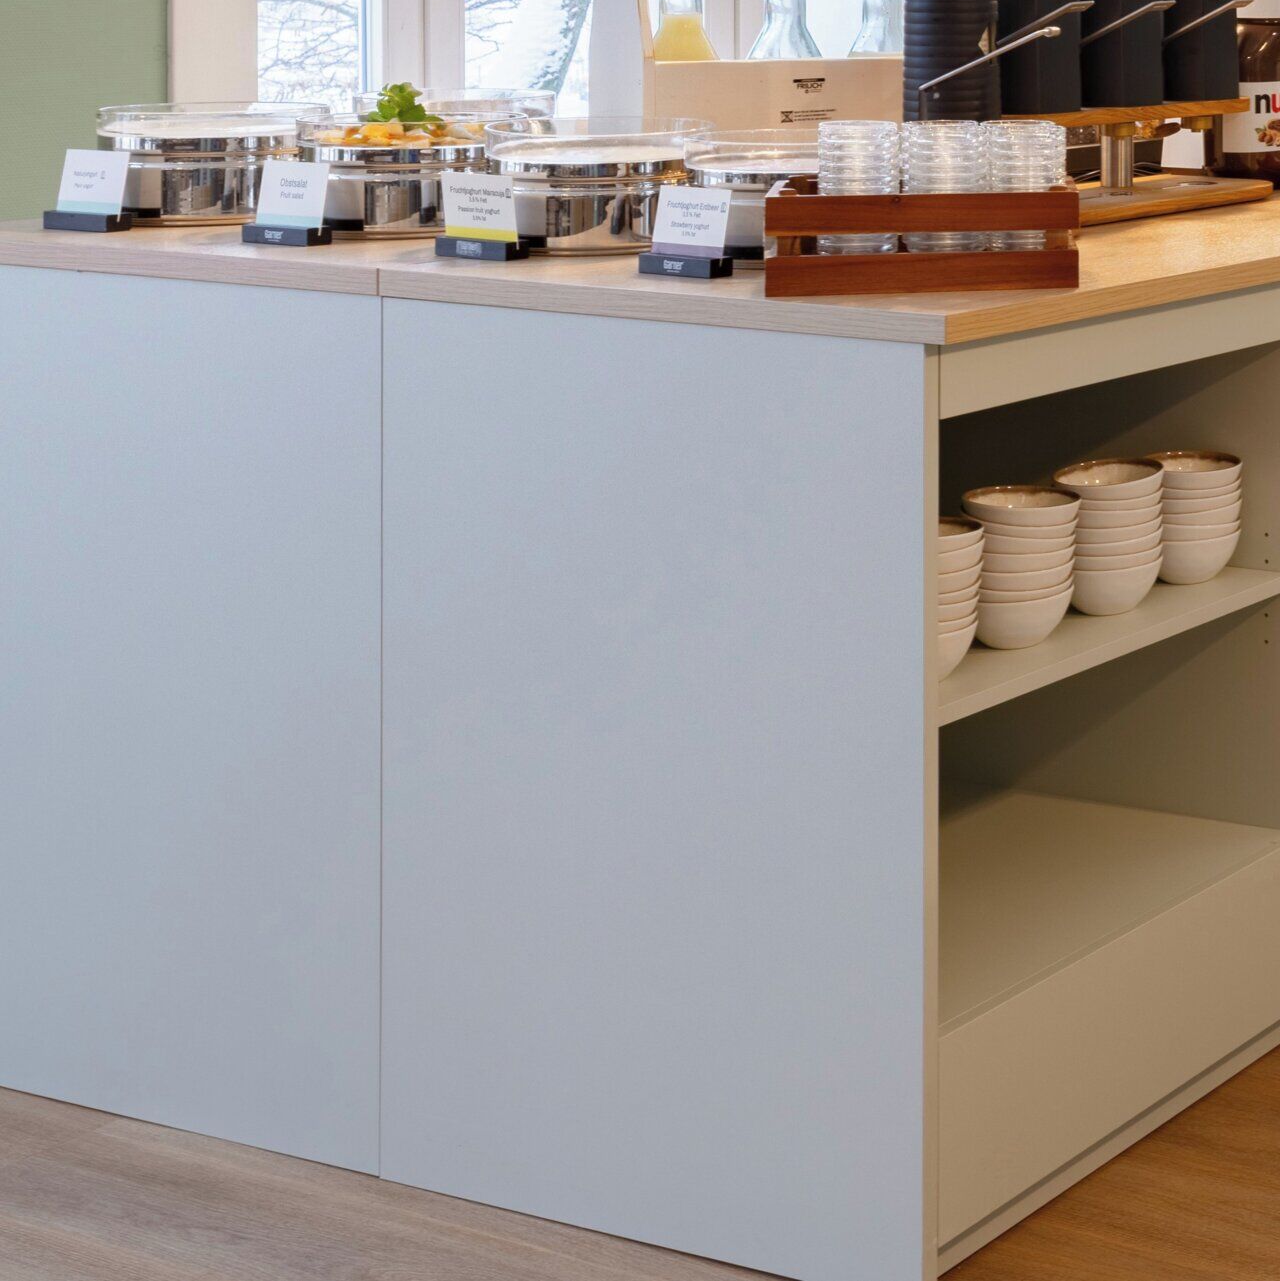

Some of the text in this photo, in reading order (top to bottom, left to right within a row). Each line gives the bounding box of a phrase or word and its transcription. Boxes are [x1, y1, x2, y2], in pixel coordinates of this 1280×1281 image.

[280, 178, 308, 188] Obstsalat
[280, 191, 304, 200] Fruit salad
